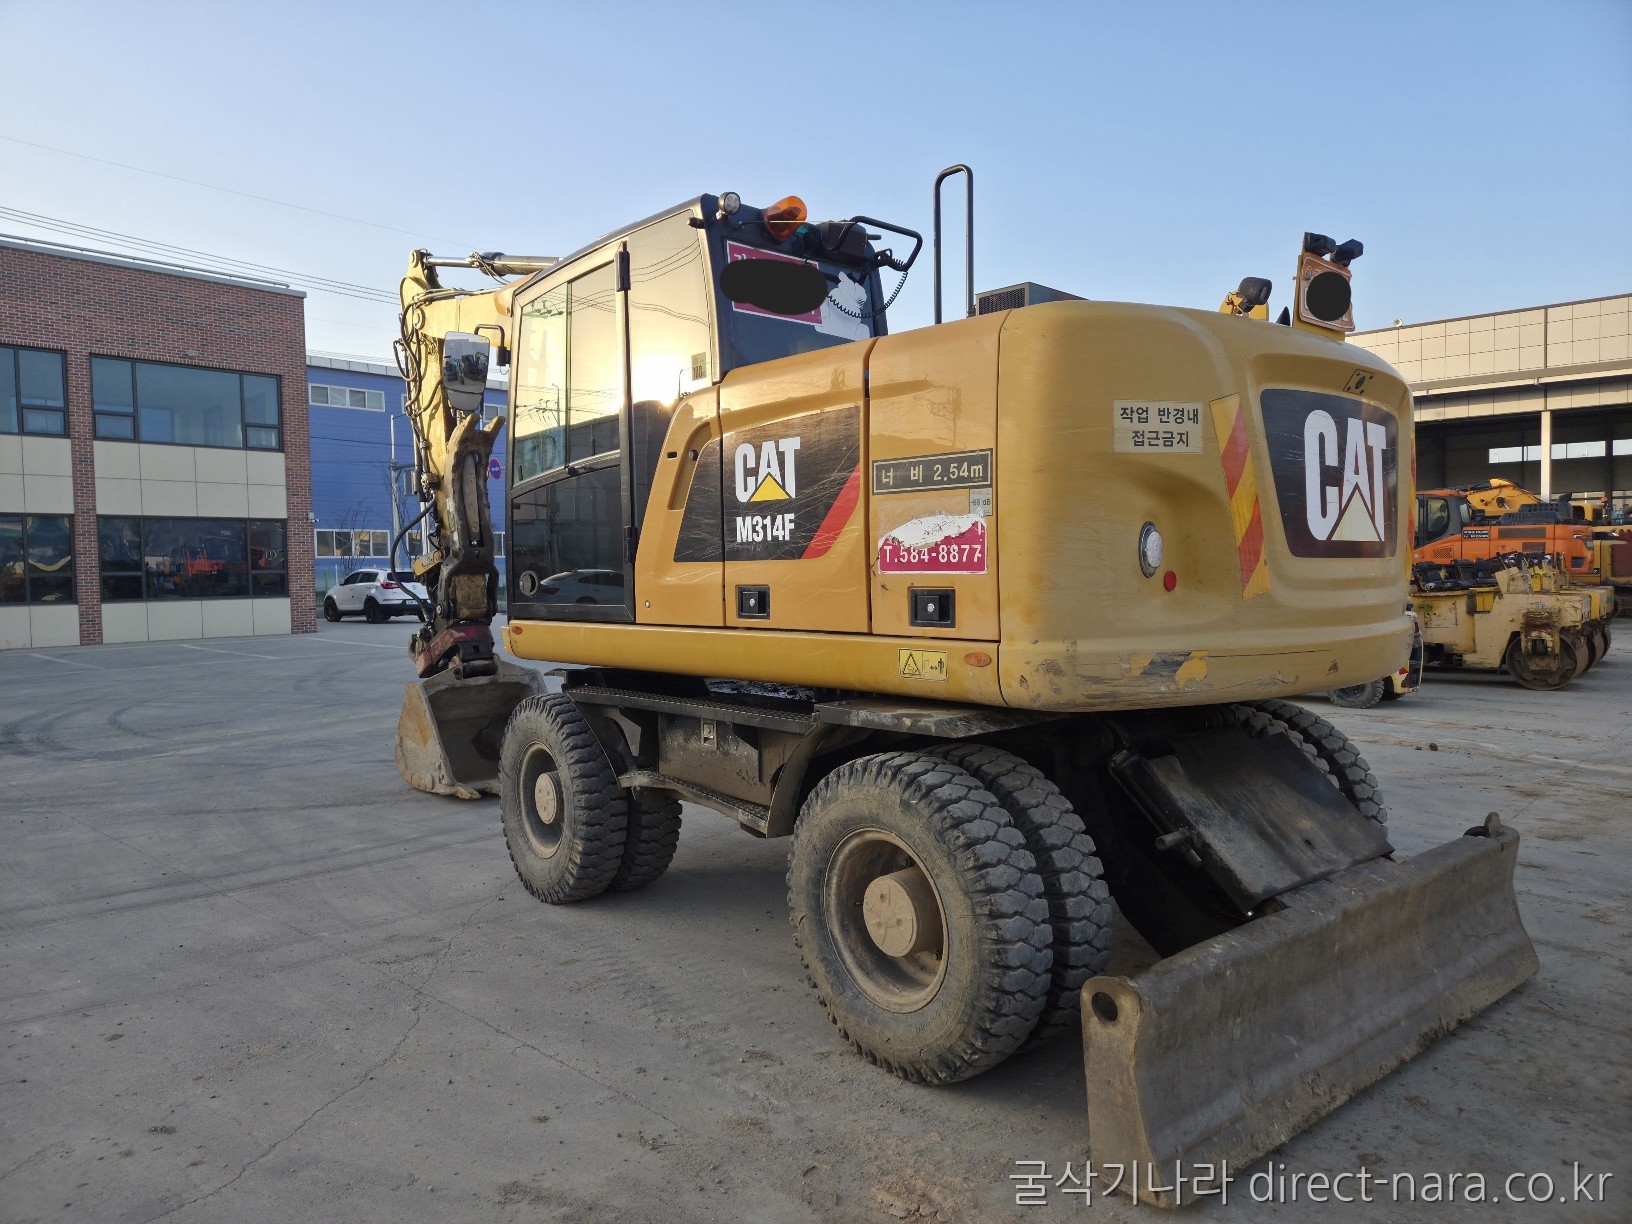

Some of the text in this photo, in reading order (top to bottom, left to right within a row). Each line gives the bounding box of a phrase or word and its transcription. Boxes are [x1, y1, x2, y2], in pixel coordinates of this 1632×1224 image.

[1120, 406, 1199, 425] 작업 반경내
[1131, 430, 1189, 448] 접근금지
[735, 436, 801, 503] CAT
[933, 461, 984, 481] 2.54m
[1304, 409, 1386, 541] CAT
[736, 513, 795, 543] M314F
